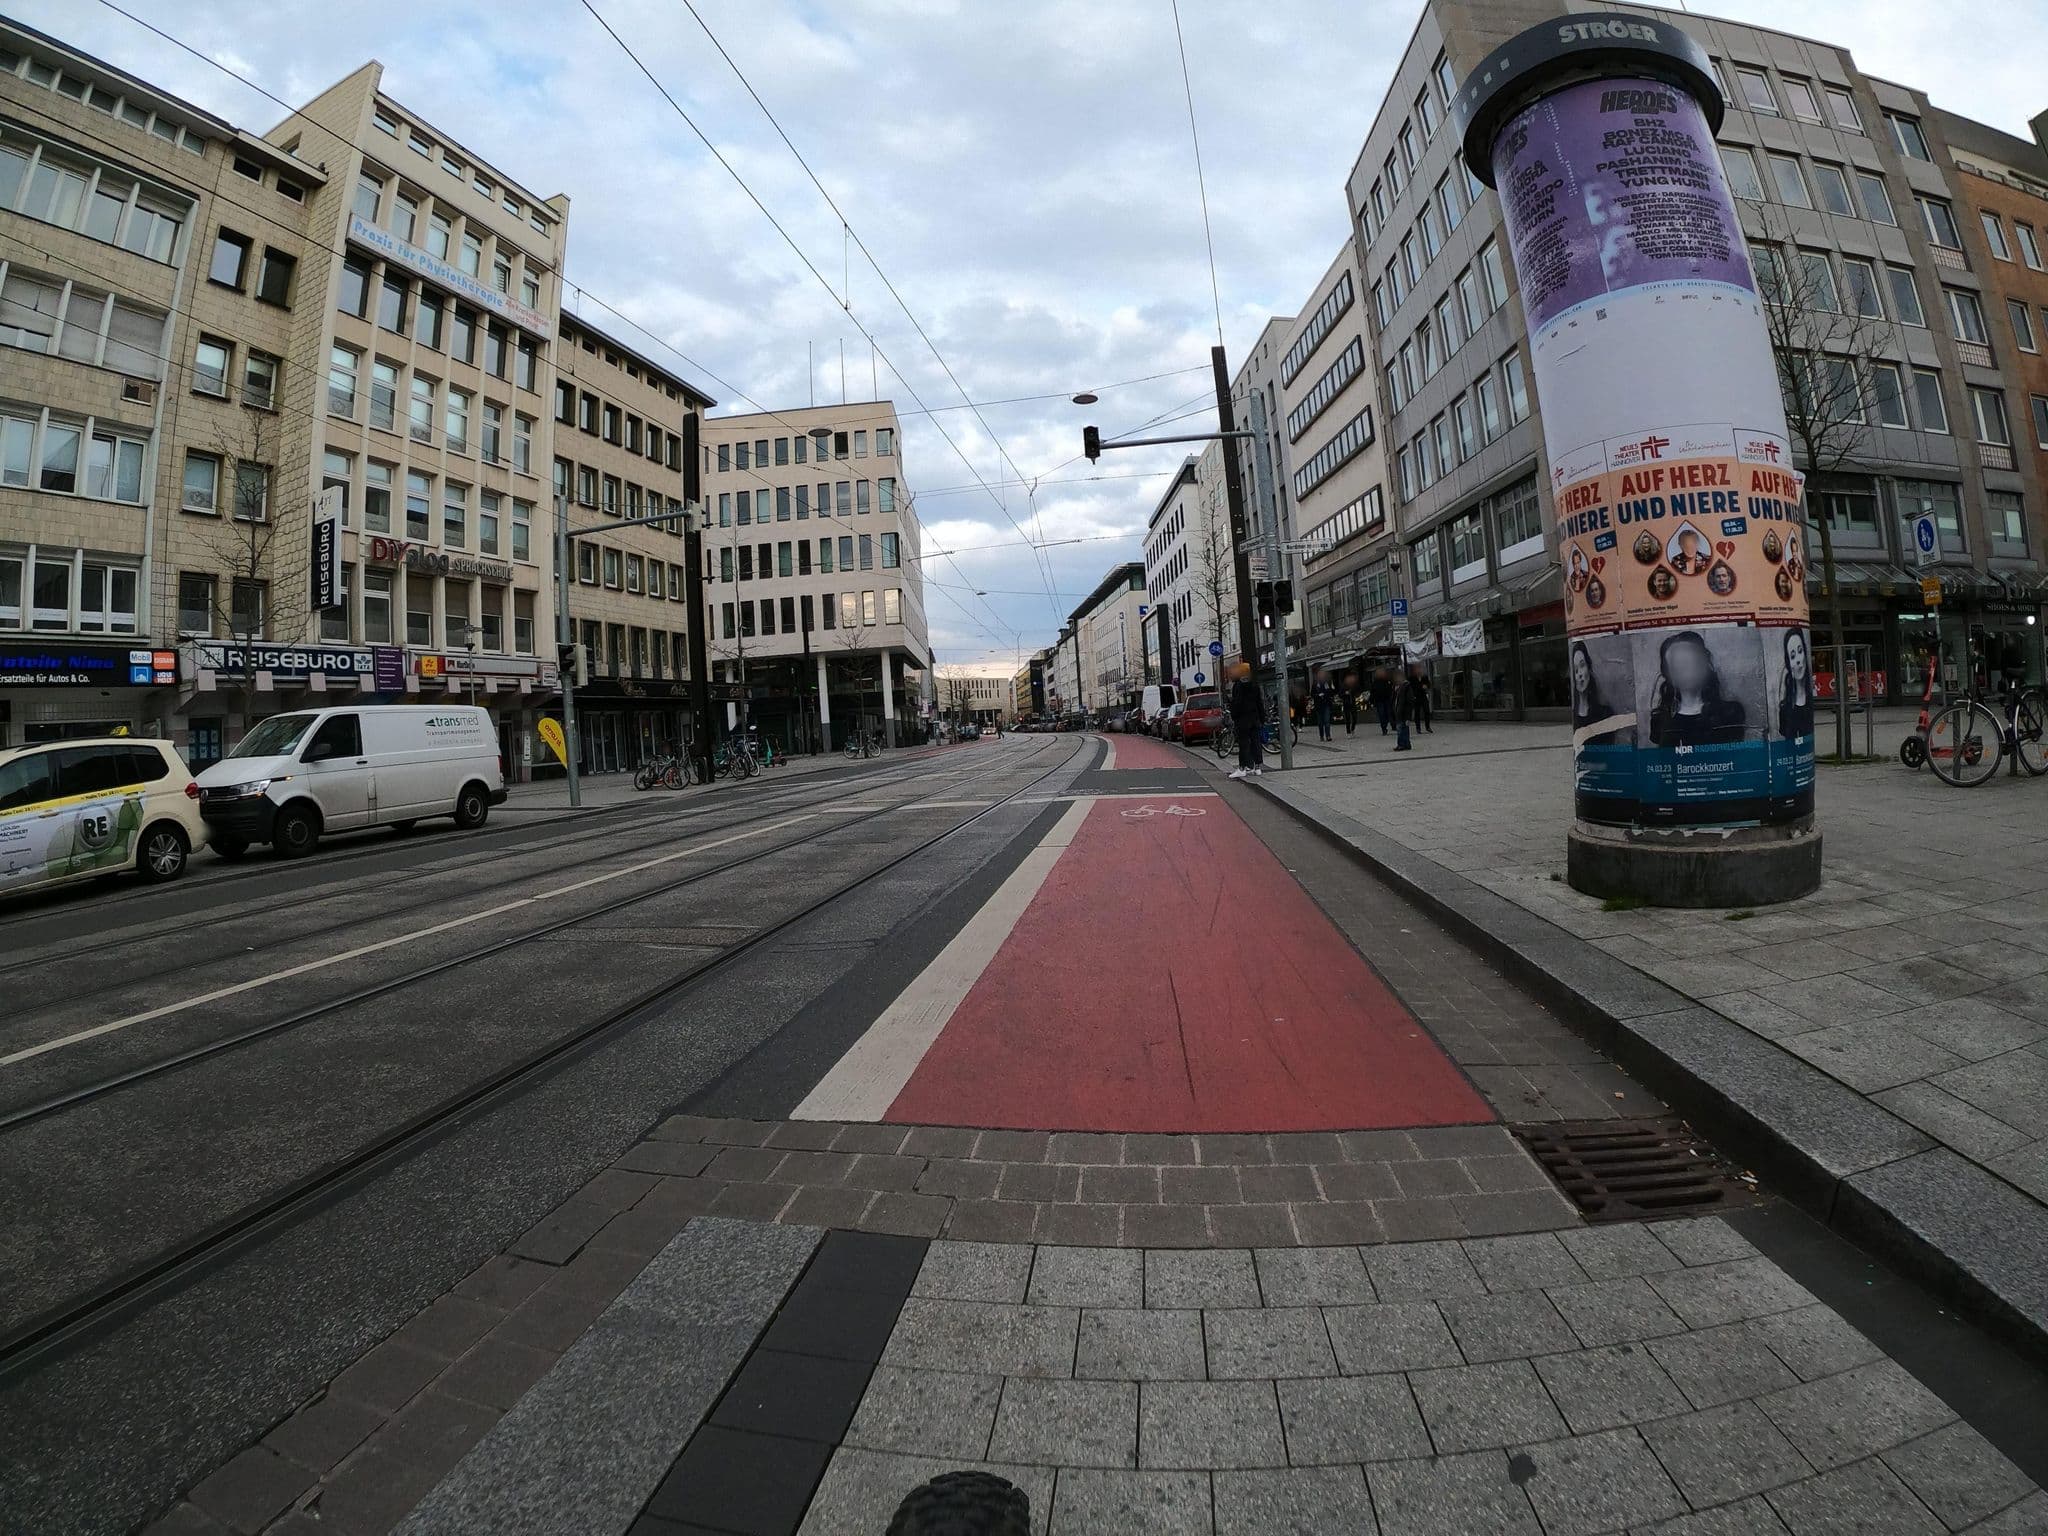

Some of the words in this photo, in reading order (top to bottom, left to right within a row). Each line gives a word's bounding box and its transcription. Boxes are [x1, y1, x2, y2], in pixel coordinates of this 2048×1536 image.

[1559, 20, 1661, 44] STRÖER
[1600, 89, 1678, 114] HEROES
[1634, 118, 1666, 128] BHZ
[1603, 128, 1659, 141] BONEZ
[1602, 137, 1635, 149] RAF
[1639, 136, 1701, 153] CAMORA
[1624, 145, 1691, 158] LUCIANO
[1596, 155, 1682, 173] PASHANIM
[1614, 166, 1709, 182] TRETTMANN
[1620, 176, 1669, 189] YUNG
[1672, 177, 1711, 192] HURN
[354, 221, 393, 250] Praxis
[420, 255, 504, 307] Physiotherapie
[1615, 450, 1640, 460] THEATER
[1619, 444, 1638, 452] NEUES
[1621, 469, 1664, 498] AUF
[1669, 463, 1731, 490] HERZ
[1751, 470, 1781, 495] AUF
[1565, 482, 1602, 513] HERZ
[1617, 496, 1666, 525] UND
[1670, 490, 1741, 517] NIERE
[1748, 496, 1782, 521] UND
[1566, 506, 1610, 539] NIERE
[320, 522, 331, 605] REISEBÜRO
[454, 558, 514, 582] SPRACHSCHULE
[1393, 601, 1402, 614] P
[131, 652, 151, 661] Mobil
[228, 651, 351, 669] REISEBÜRO
[36, 673, 47, 683] für
[49, 674, 69, 683] Autos
[78, 674, 91, 683] Co.
[435, 716, 479, 727] transmed
[426, 728, 481, 736] Transportmanagement
[1675, 742, 1694, 755] NDR
[1646, 764, 1672, 773] 24.03.23
[1677, 761, 1734, 774] Barockkonzert
[83, 816, 108, 839] RE
